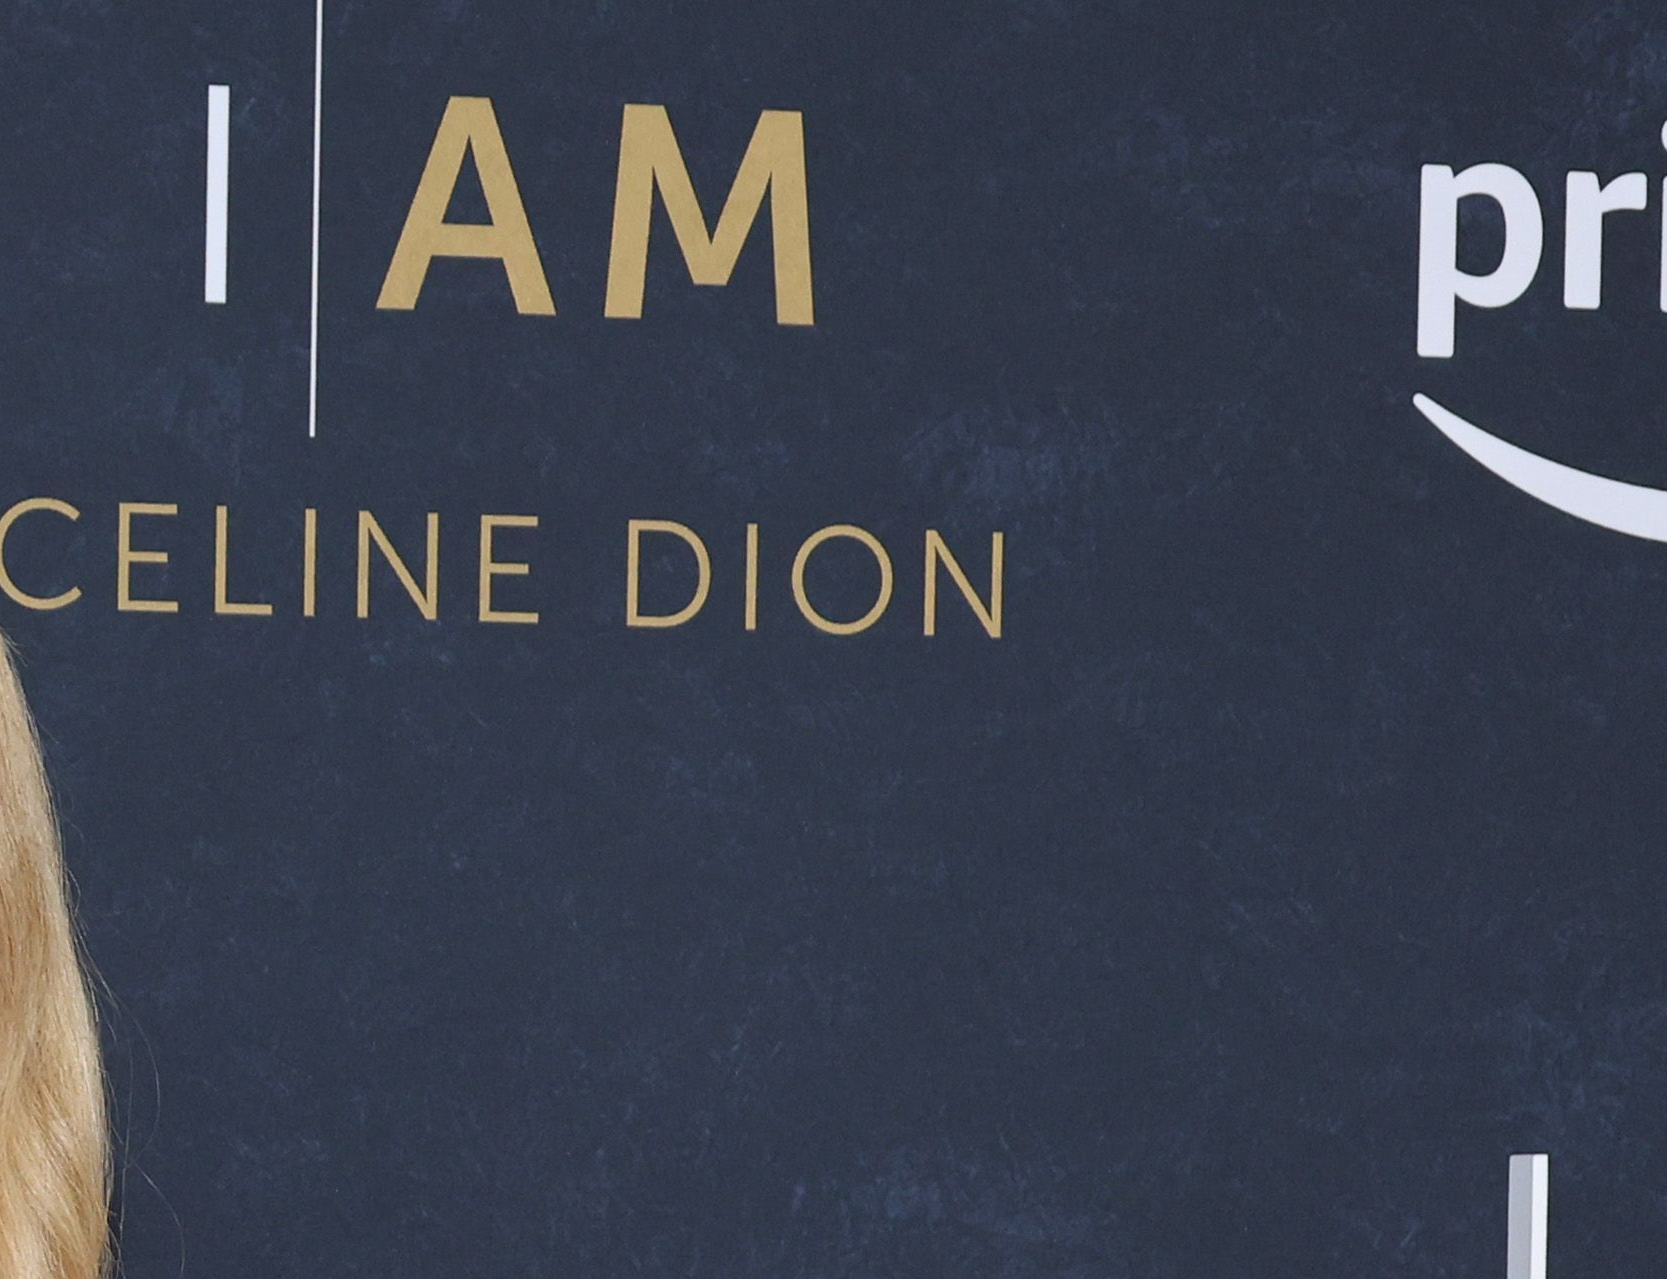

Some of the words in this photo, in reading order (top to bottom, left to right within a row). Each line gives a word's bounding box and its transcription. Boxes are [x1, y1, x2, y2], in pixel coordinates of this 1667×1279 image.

[205, 85, 230, 304] I
[376, 95, 815, 326] AM
[1416, 118, 1667, 358] pr
[626, 518, 1005, 638] DION
